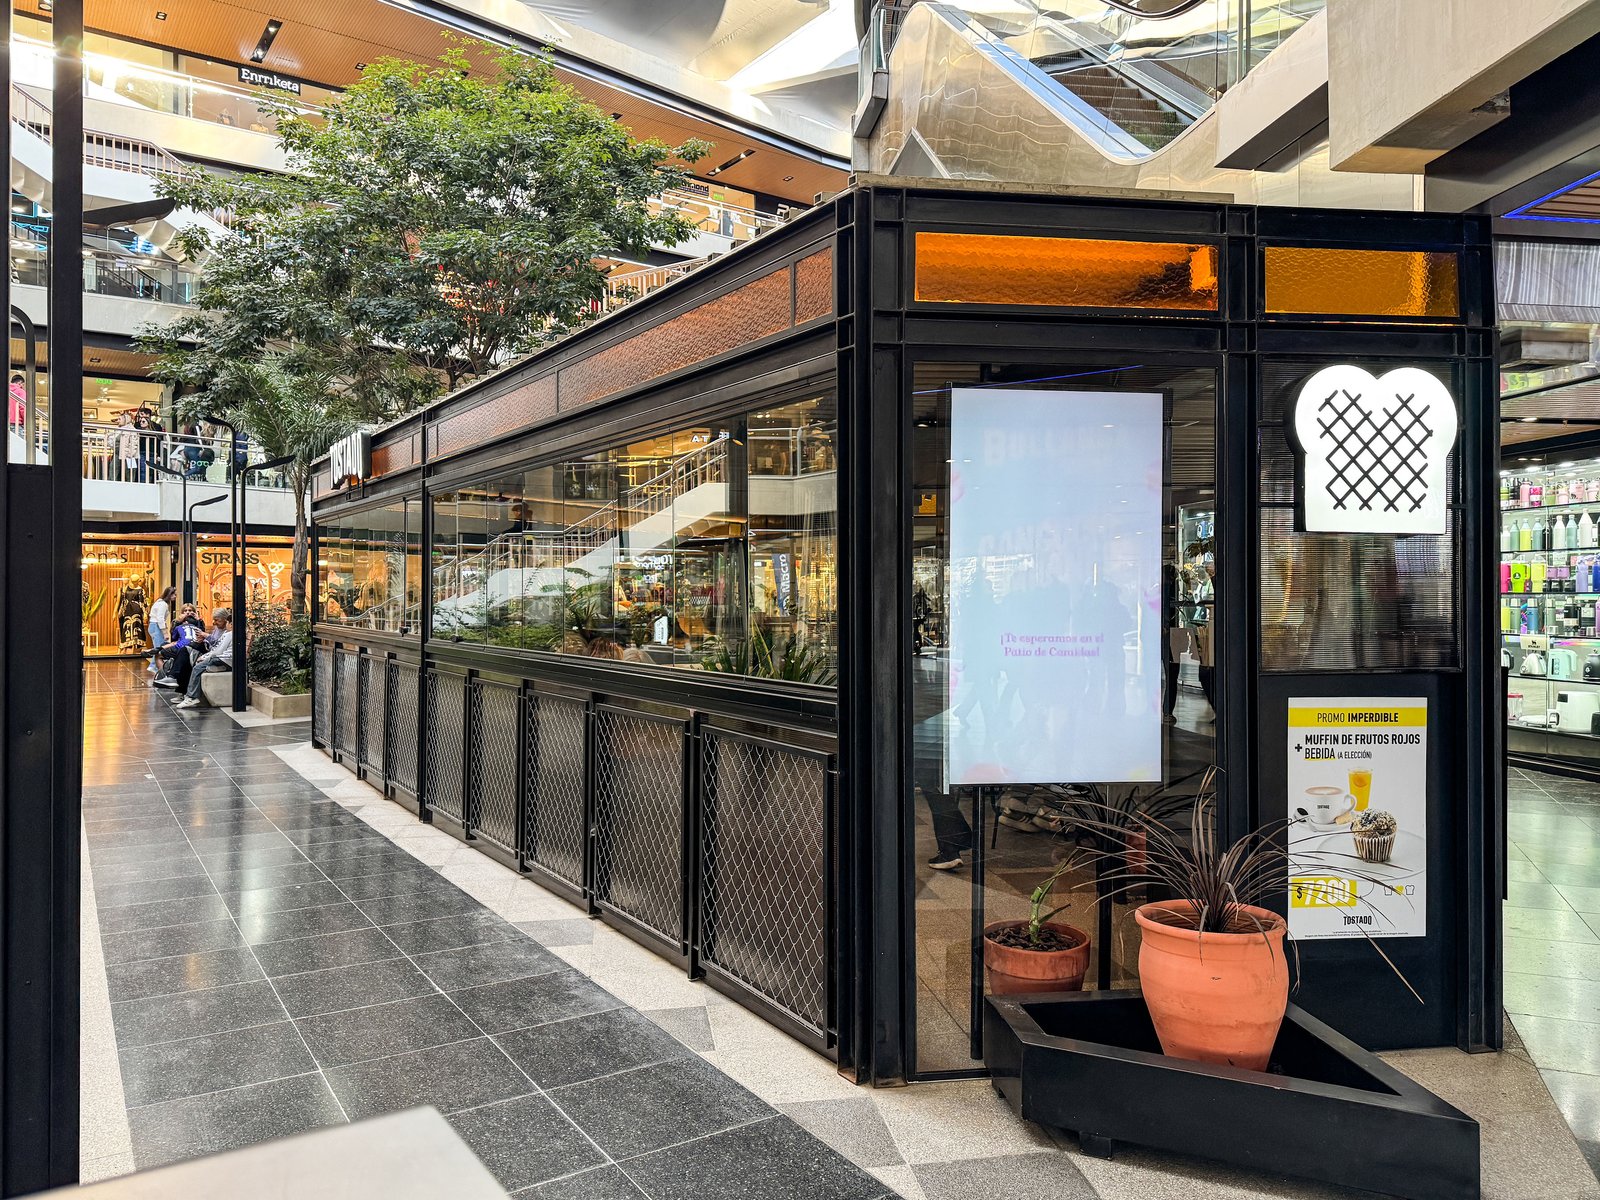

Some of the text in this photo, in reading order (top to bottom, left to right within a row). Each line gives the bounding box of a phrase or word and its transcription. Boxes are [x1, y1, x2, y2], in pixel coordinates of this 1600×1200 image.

[1019, 633, 1077, 645] esperamos
[1004, 647, 1033, 657] Patio
[1317, 712, 1399, 723] PROMO IMPERDIBLE
[1305, 733, 1421, 745] MUFFIN DE FRUTOS ROJOS
[1304, 747, 1336, 760] BEBIDA
[1343, 915, 1373, 926] TOSTADO
